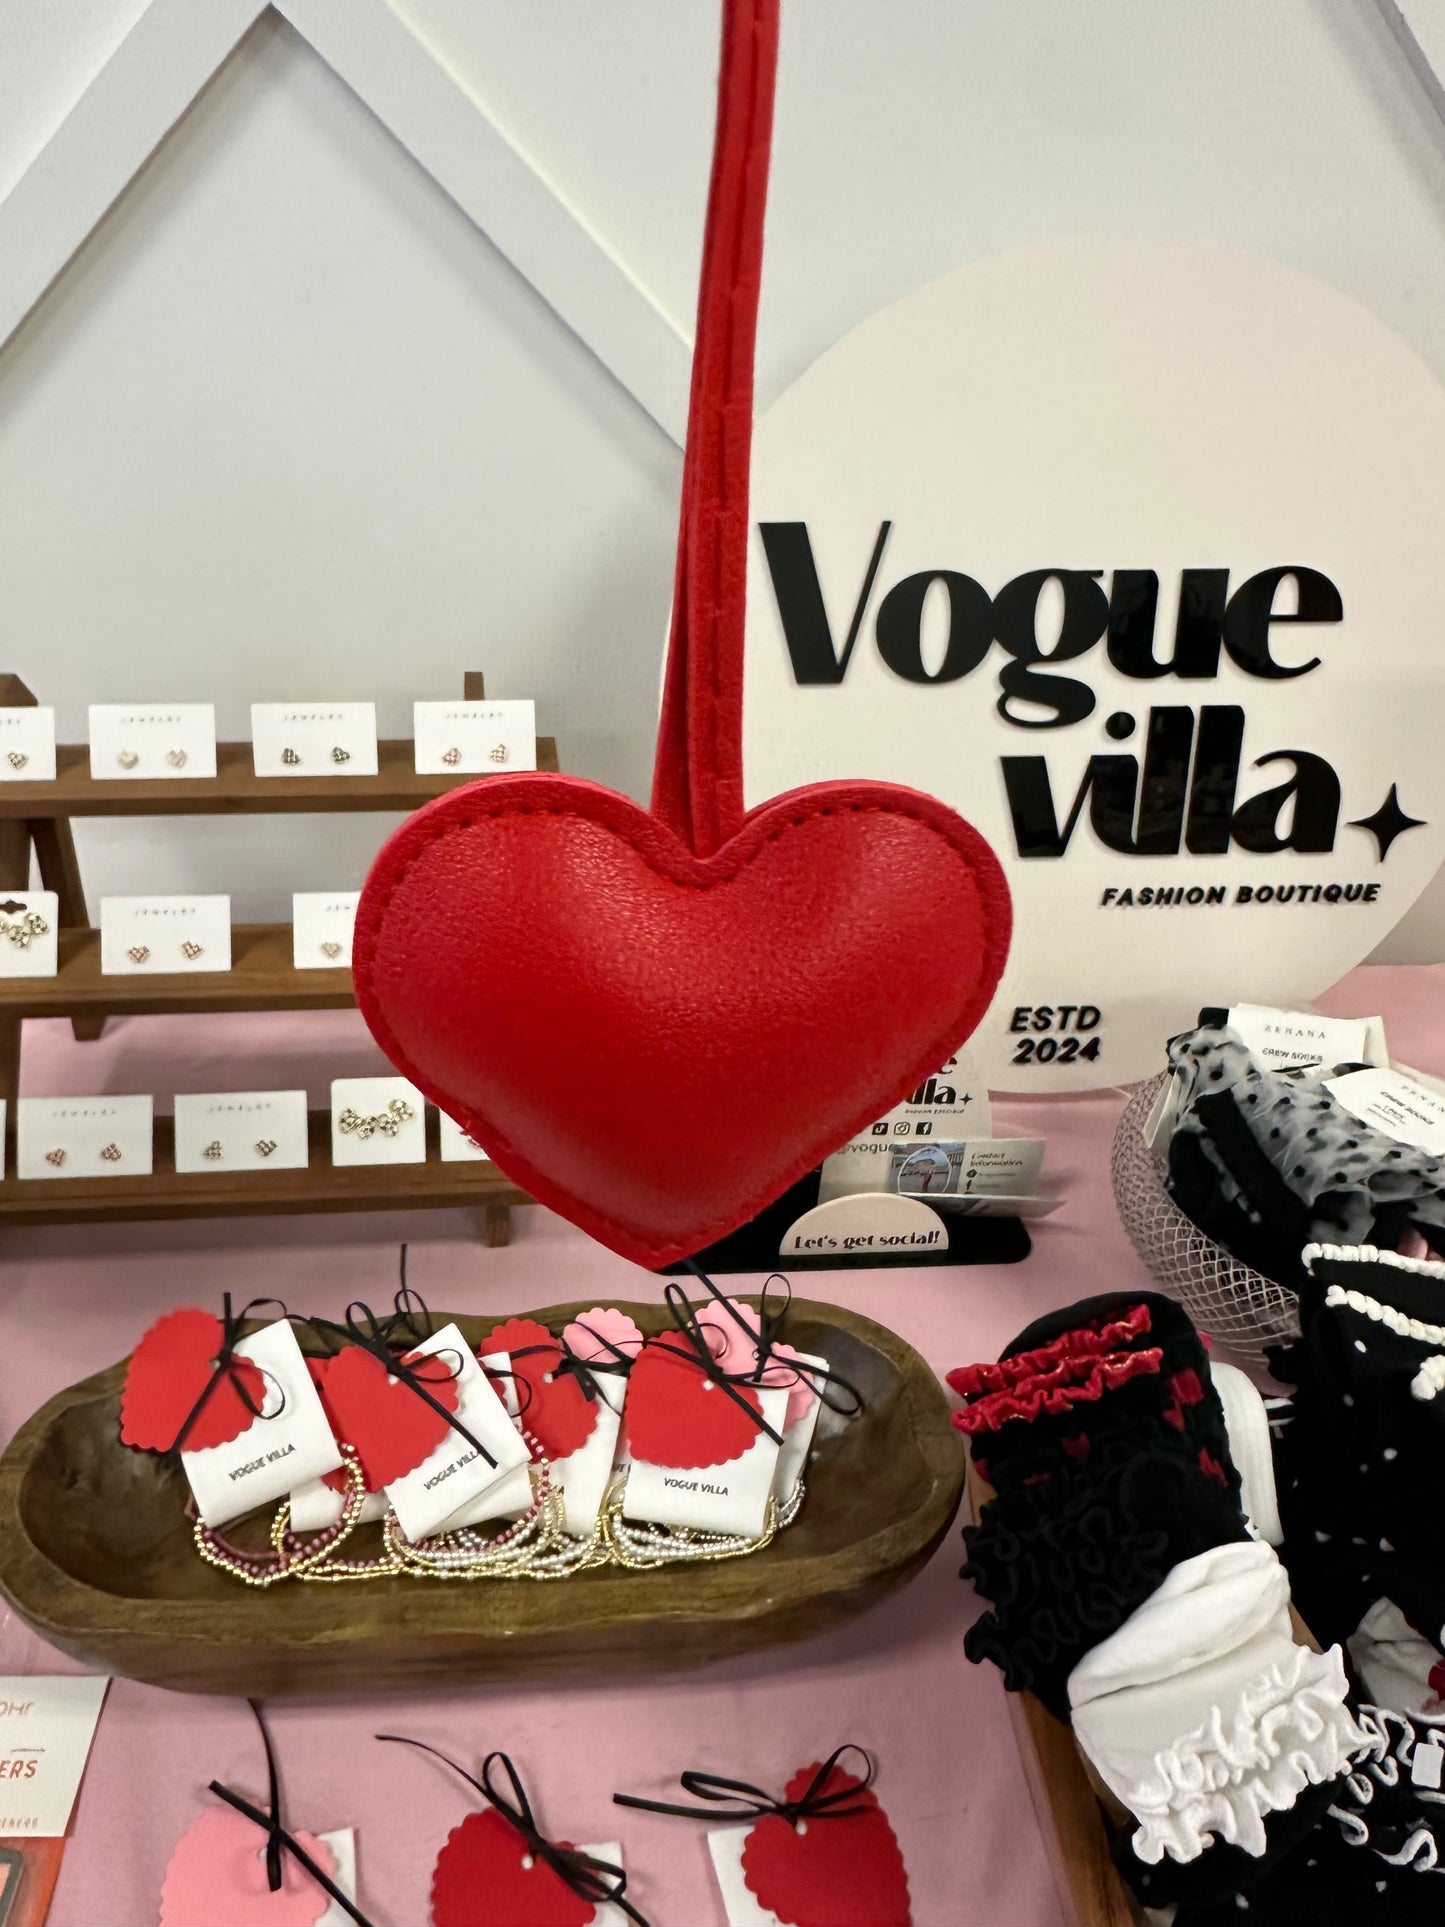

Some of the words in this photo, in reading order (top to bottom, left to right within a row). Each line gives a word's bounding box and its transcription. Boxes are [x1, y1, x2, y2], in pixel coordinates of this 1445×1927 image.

[758, 521, 1344, 729] Vogue
[1000, 705, 1342, 858] villa
[1099, 886, 1227, 907] FASHION
[1234, 883, 1381, 904] BOUTIQUE
[1009, 1005, 1102, 1032] ESTD
[1011, 1036, 1101, 1064] 2024
[794, 1235, 838, 1249] Let's
[843, 1235, 874, 1250] get
[879, 1230, 940, 1246] social!
[228, 1457, 266, 1481] VOGUE
[265, 1443, 296, 1462] VILLA
[423, 1463, 458, 1490] VOGUE
[456, 1450, 482, 1468] VILL
[664, 1477, 699, 1492] VOGUE
[700, 1483, 729, 1496] VILLA
